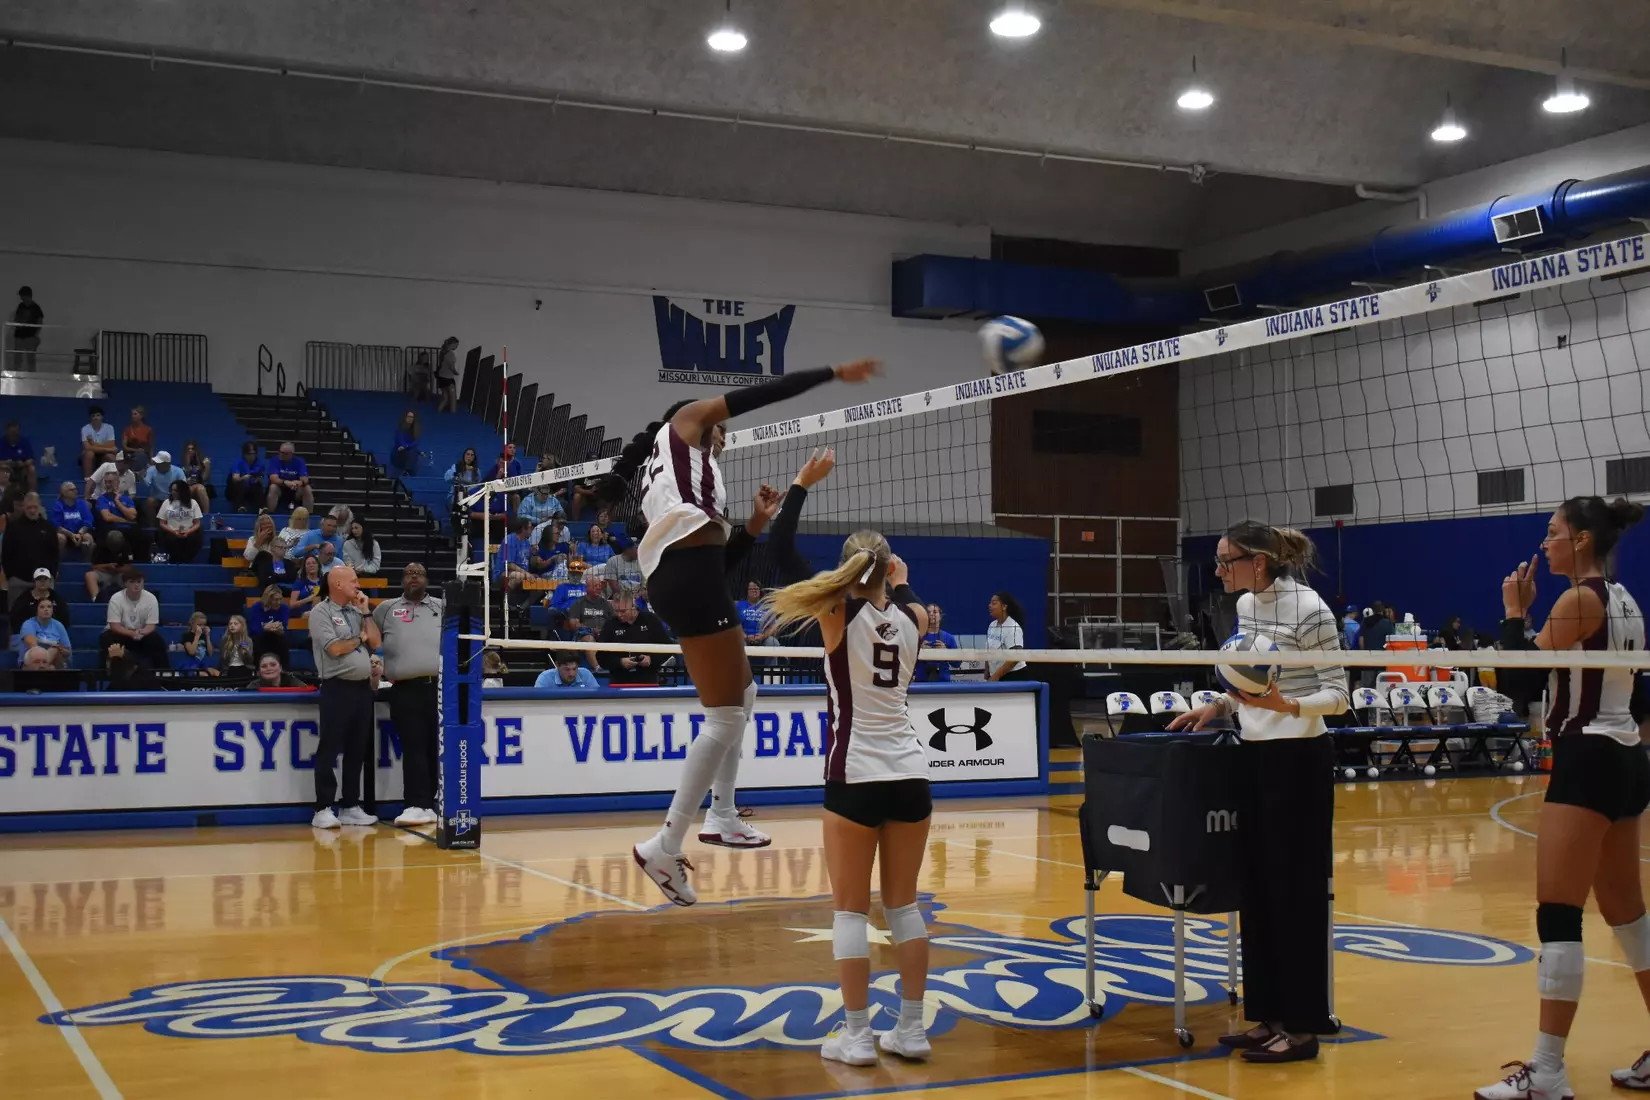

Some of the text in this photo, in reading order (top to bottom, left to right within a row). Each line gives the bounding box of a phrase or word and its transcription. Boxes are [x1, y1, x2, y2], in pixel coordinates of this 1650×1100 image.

[1492, 236, 1645, 291] INDIANA STATE
[703, 299, 745, 316] THE
[1265, 295, 1380, 337] INDIANA STATE
[652, 295, 796, 376] VALLEY
[1092, 338, 1180, 373] INDIANA STATE
[659, 371, 773, 386] MISSOURI VALLEY CONFERE
[955, 371, 1027, 401] INDIANA STATE
[844, 398, 903, 423] INDIANA STATE
[752, 419, 801, 441] INDIANA STATE
[873, 642, 900, 688] 9
[0, 711, 829, 778] STATE SYCME VOLLBA
[459, 740, 468, 804] sports imports
[928, 758, 1004, 768] NDER ARMOUR
